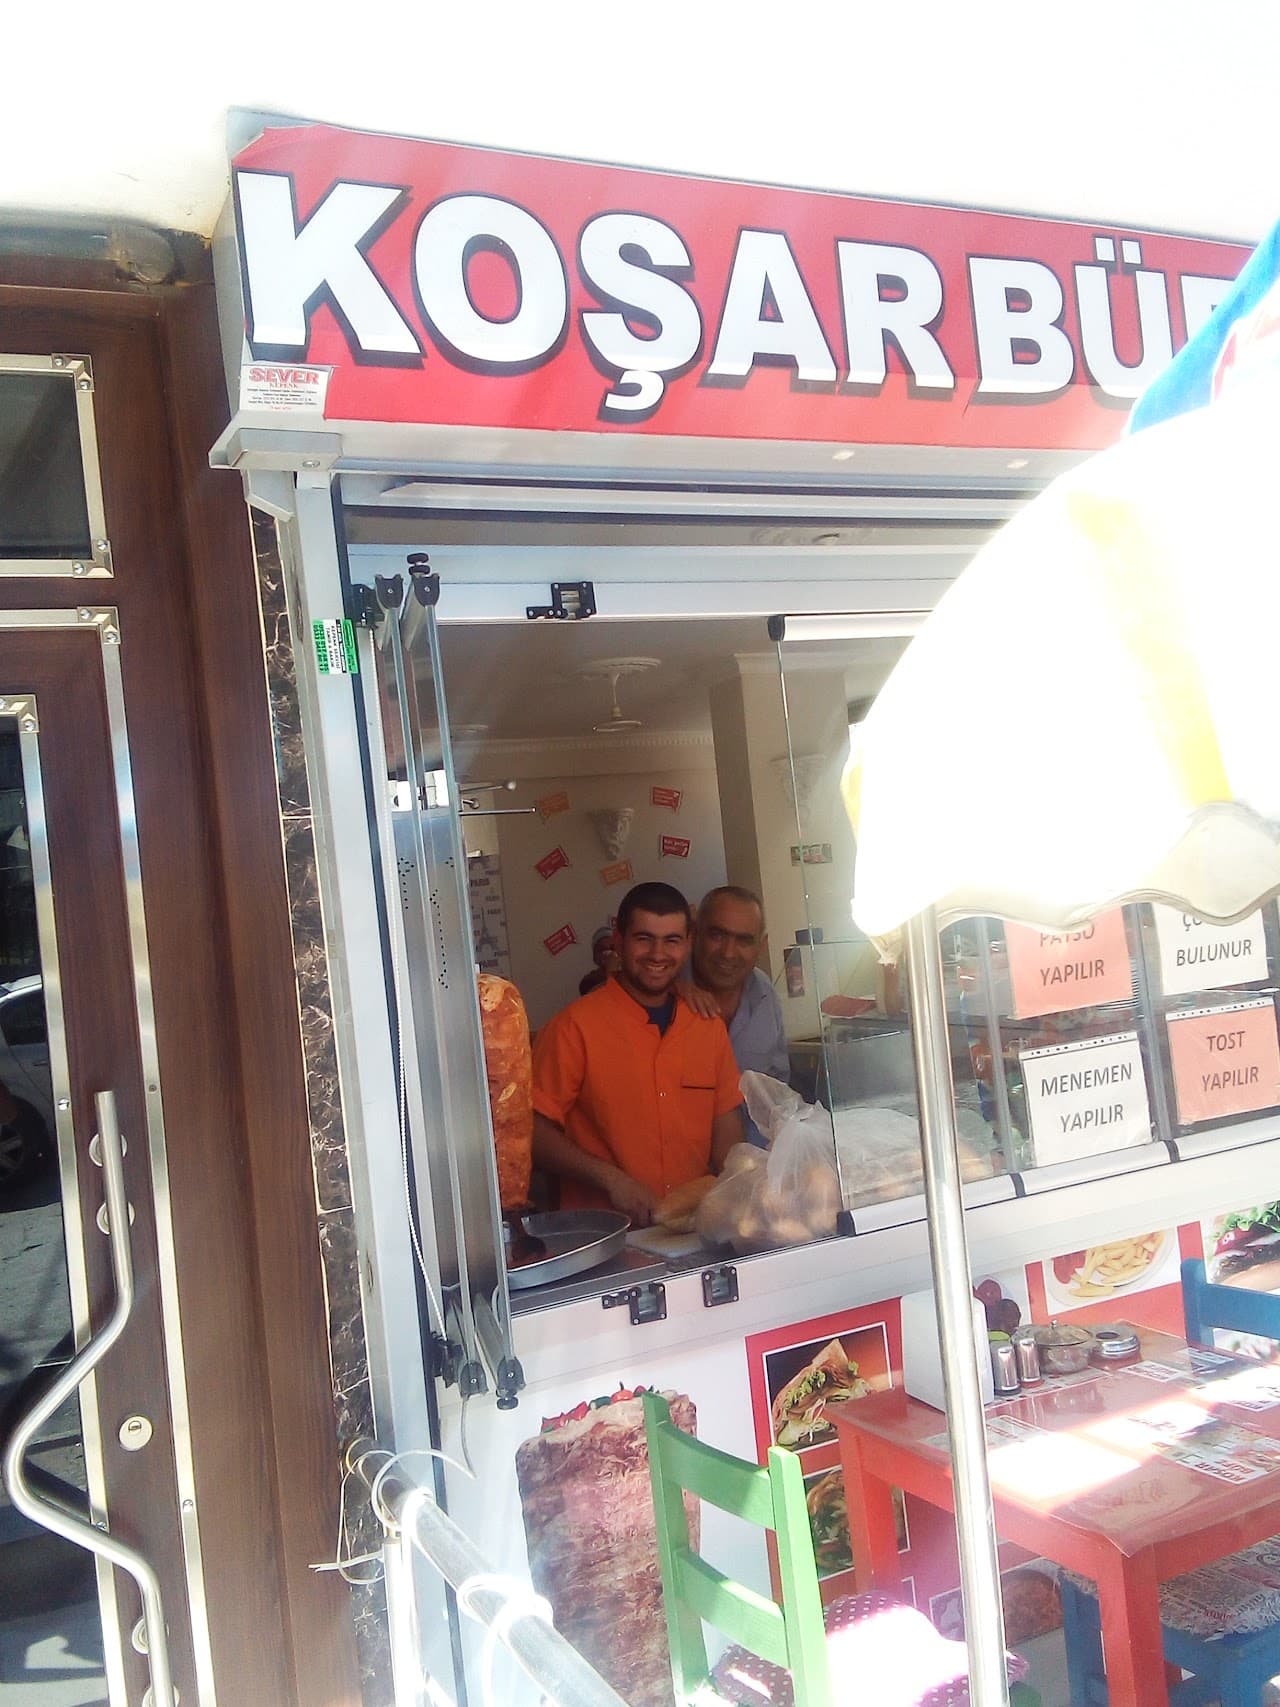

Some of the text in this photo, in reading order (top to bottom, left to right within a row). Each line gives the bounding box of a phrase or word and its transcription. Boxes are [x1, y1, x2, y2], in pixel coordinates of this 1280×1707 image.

[249, 367, 320, 385] SEVER
[1176, 939, 1252, 966] BULUNUR
[1040, 959, 1105, 986] YAPILIR
[1206, 1031, 1246, 1052] TOST
[1041, 1062, 1132, 1097] MENEMEN
[1202, 1066, 1259, 1092] YAPILIR
[1060, 1104, 1124, 1133] YAPILIR
